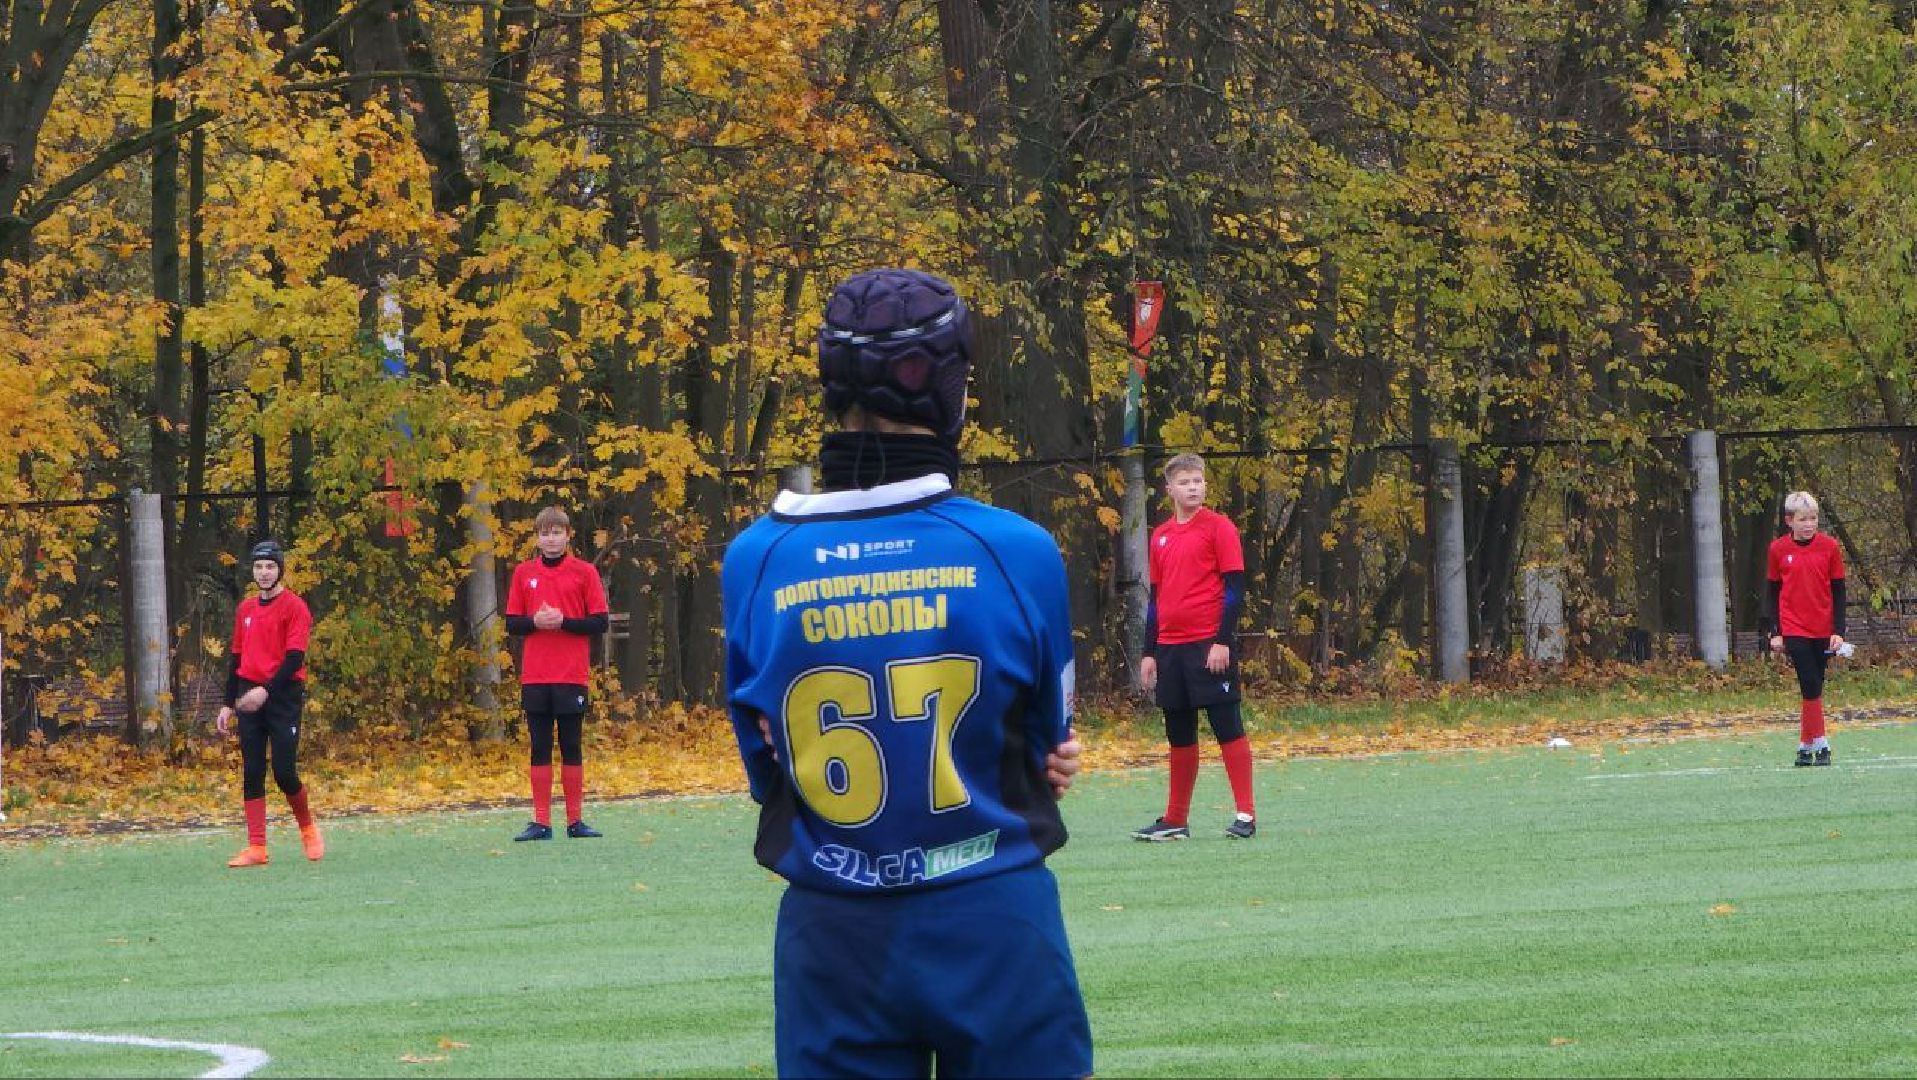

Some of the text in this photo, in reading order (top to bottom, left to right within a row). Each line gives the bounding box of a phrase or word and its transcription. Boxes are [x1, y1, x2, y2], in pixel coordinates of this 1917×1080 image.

[863, 539, 915, 552] SPORT
[802, 593, 947, 643] СОКОЛЫ
[782, 653, 981, 829] 67
